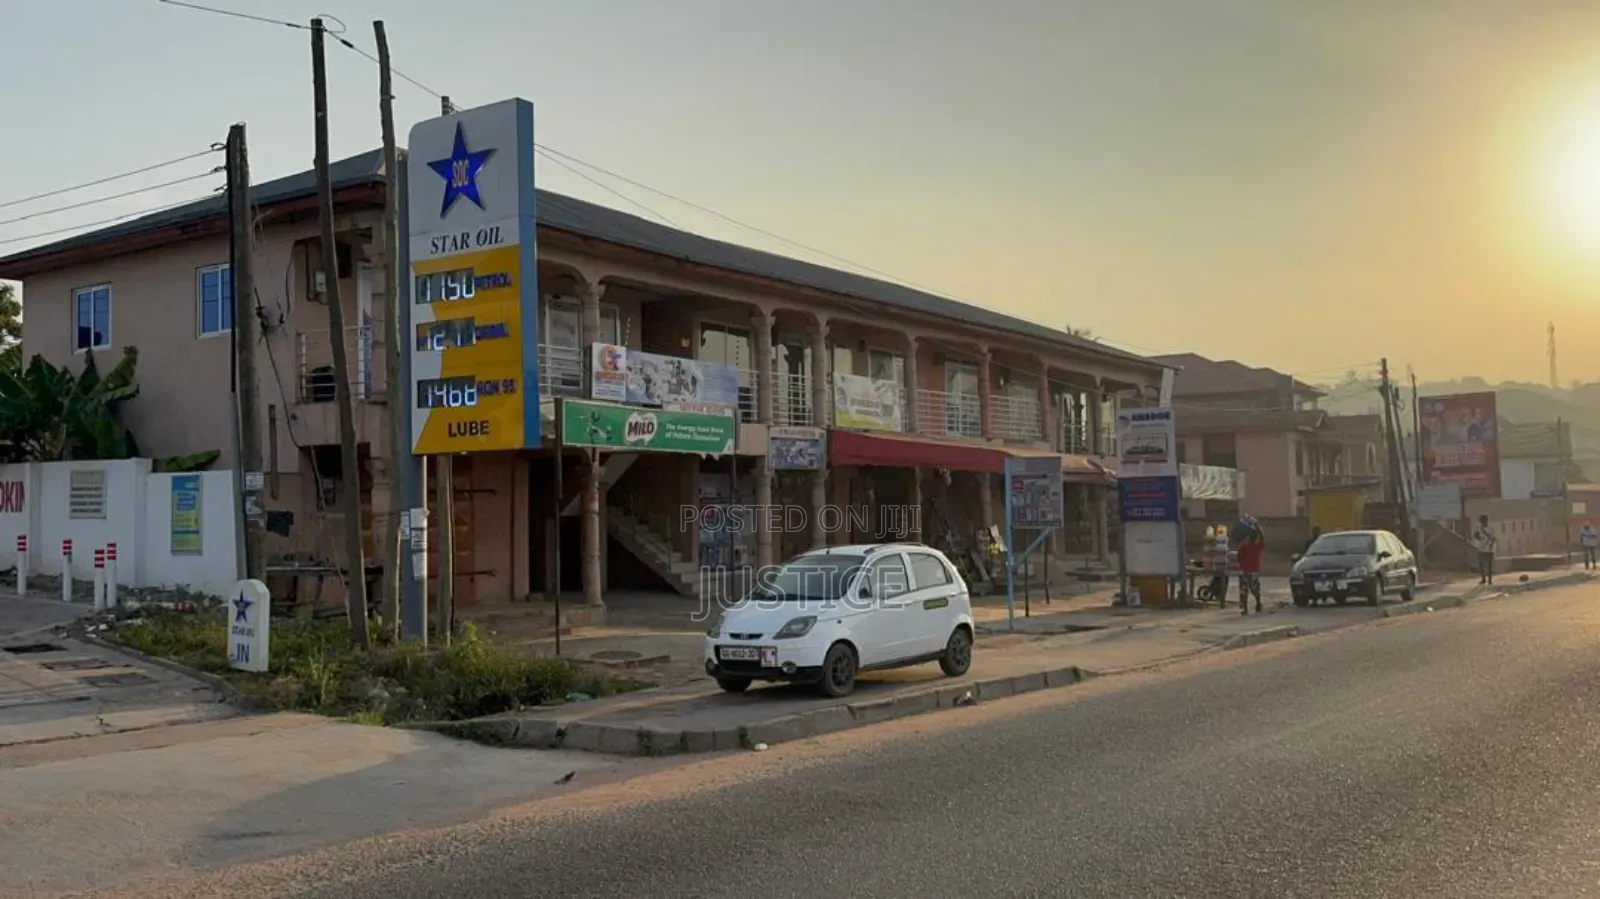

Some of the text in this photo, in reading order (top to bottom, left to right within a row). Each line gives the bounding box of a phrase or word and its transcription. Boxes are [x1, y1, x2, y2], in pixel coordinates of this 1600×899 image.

[430, 226, 504, 255] STAR OIL
[448, 420, 490, 438] LUBE
[627, 420, 655, 437] MILO
[236, 643, 250, 664] IN
